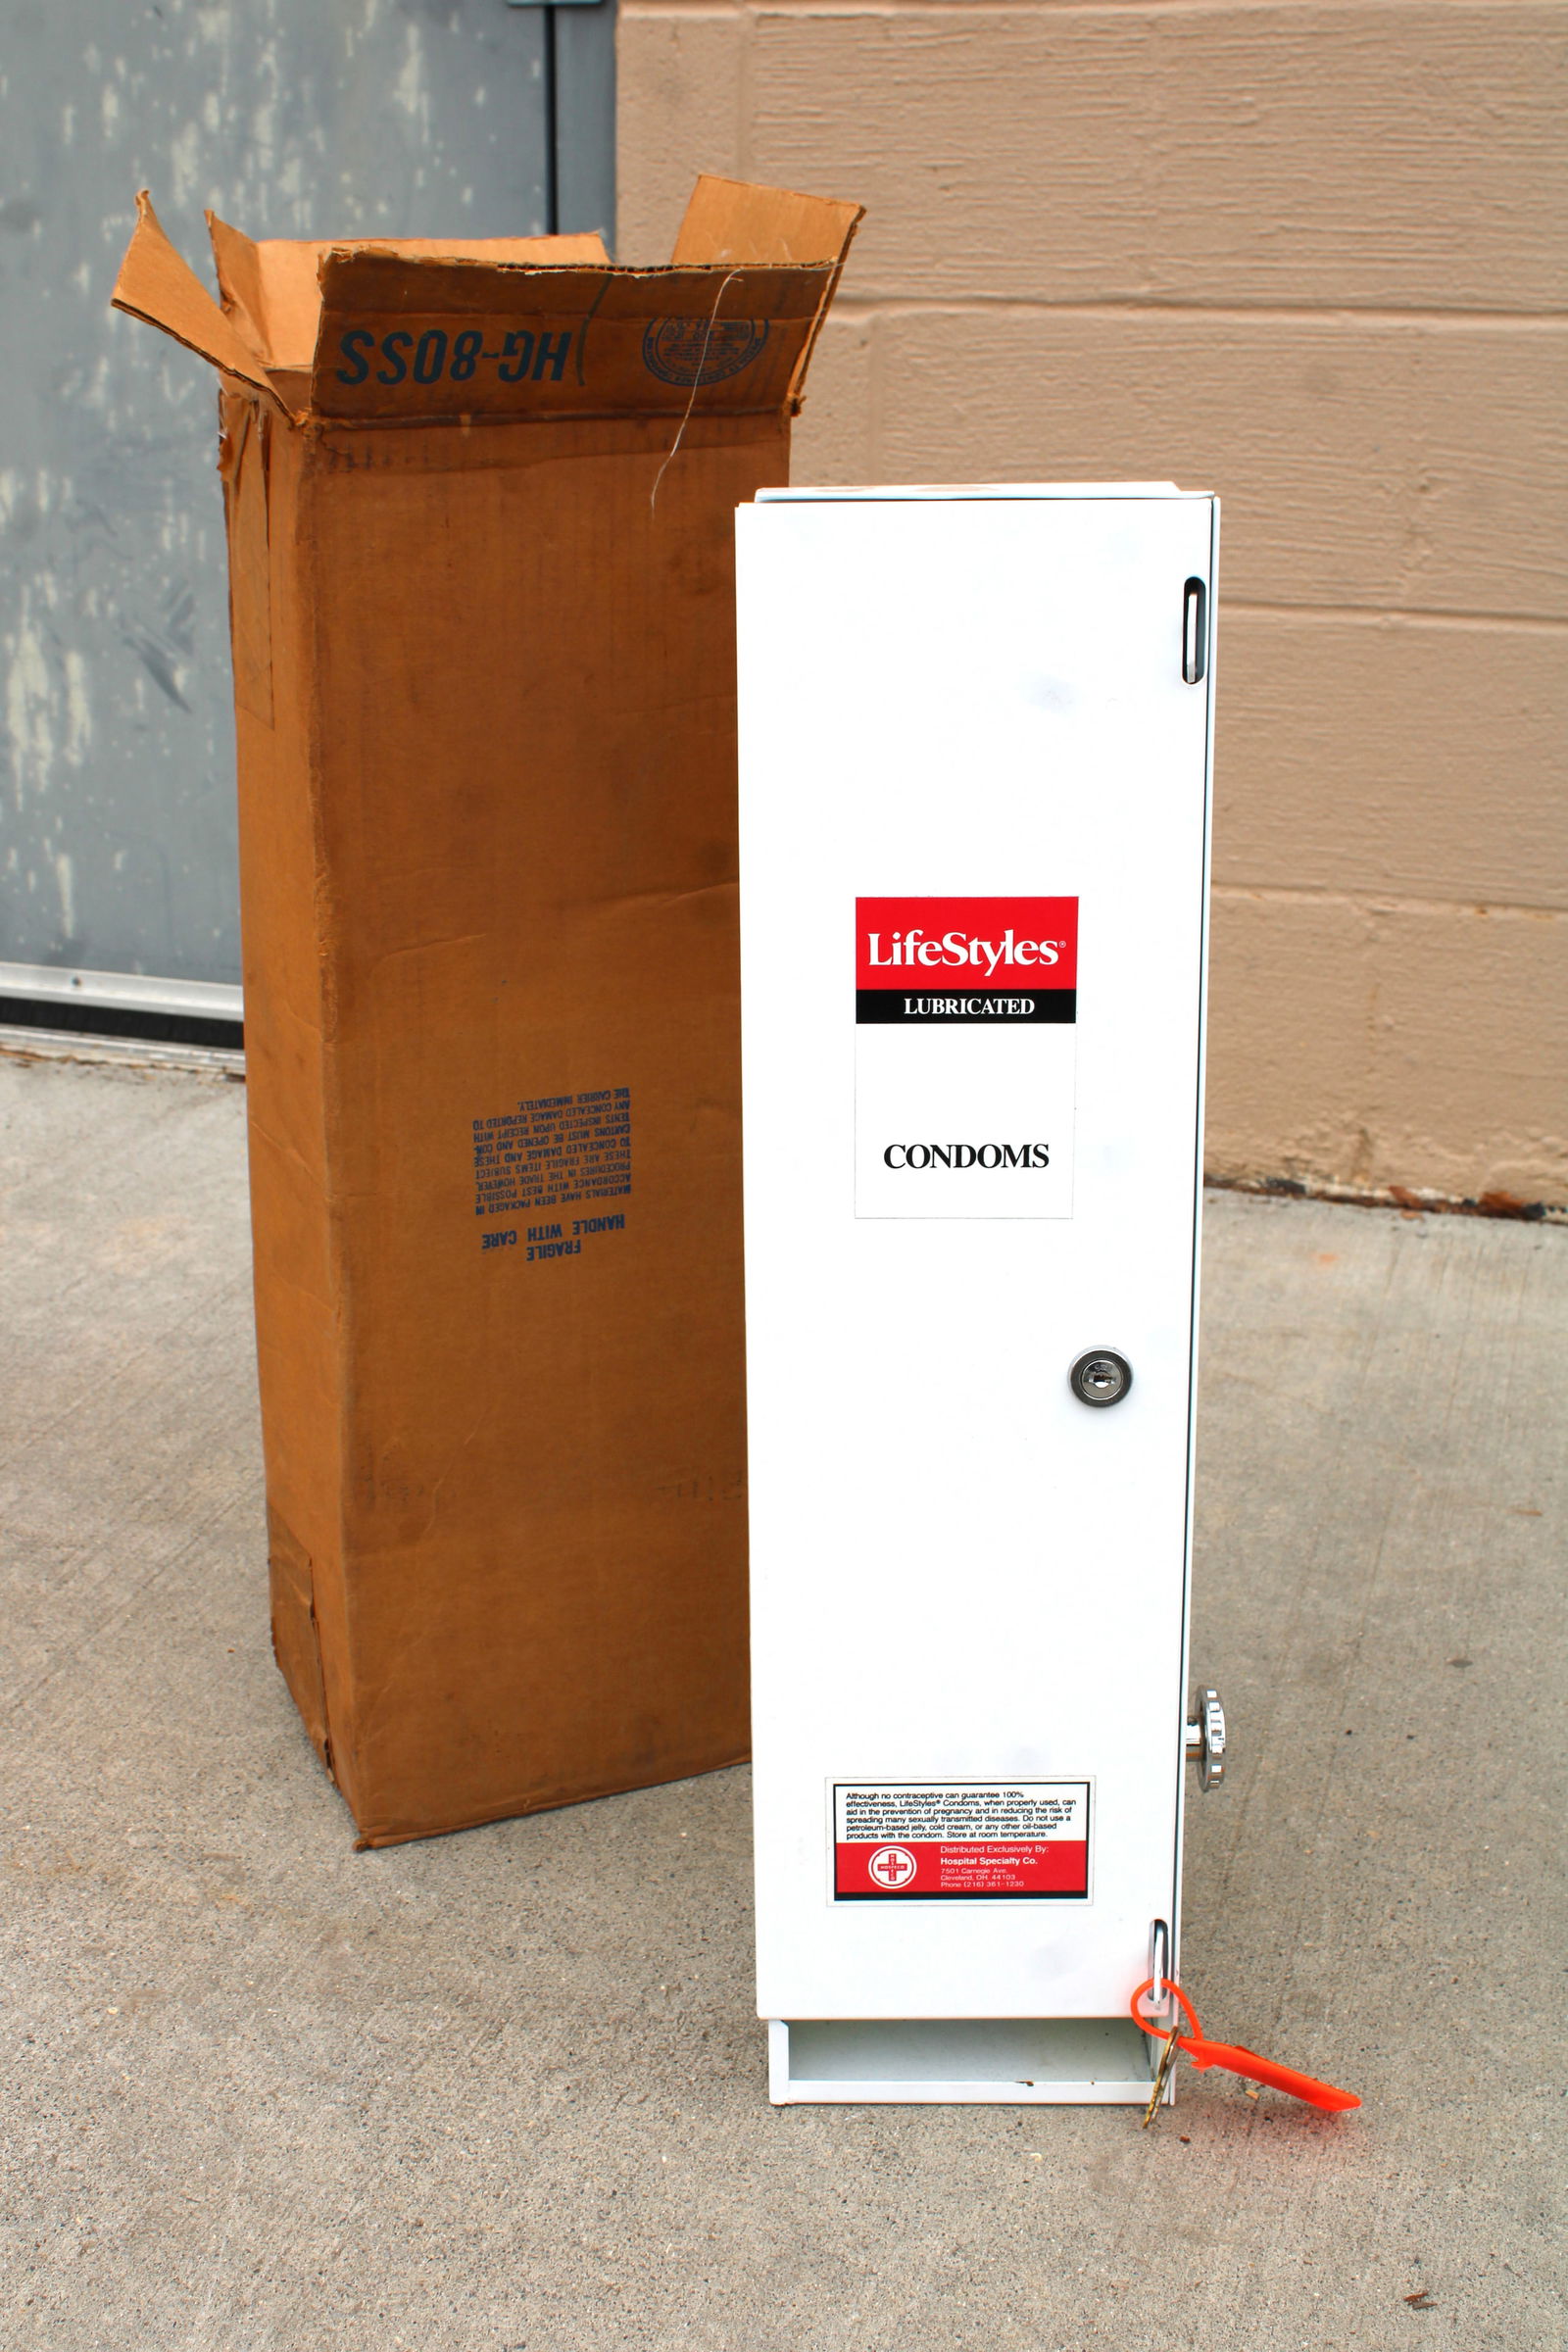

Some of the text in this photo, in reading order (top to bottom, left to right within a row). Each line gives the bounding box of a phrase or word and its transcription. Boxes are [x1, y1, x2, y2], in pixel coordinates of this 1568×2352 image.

[904, 998, 1035, 1015] LUBRICATED
[576, 1090, 611, 1103] CARRIER
[613, 1087, 630, 1099] THE
[472, 1101, 630, 1131] ANY CONCEALED DAMAGE REPORTED TO
[533, 1123, 556, 1134] UPON
[560, 1116, 601, 1132] INSPECTED
[473, 1132, 494, 1143] WITH
[498, 1126, 529, 1139] RECEIPT
[568, 1130, 589, 1142] MUST
[595, 1123, 630, 1139] CARTONS
[517, 1135, 549, 1149] OPENED
[553, 1134, 564, 1144] BE
[474, 1137, 630, 1167] TO CONCEALED DAMAGE AND THESE
[497, 1141, 514, 1152] AND
[884, 1144, 1050, 1168] CONDOMS
[475, 1149, 631, 1179] THESE ARE FRAGILE ITEMS SUBJECT
[580, 1161, 631, 1176] PROCEDURES
[549, 1171, 563, 1181] THE
[568, 1169, 576, 1178] IN
[475, 1172, 631, 1203] ACCORDANCE WITH BEST POSSIBLE
[586, 1184, 631, 1199] MATERIALS
[535, 1195, 556, 1206] BEEN
[561, 1189, 581, 1202] HAVE
[489, 1199, 530, 1212] PACKAGED
[482, 1213, 625, 1249] HANDLE WITH CARE
[526, 1240, 581, 1261] FRAGILE
[941, 1844, 1049, 1854] Distributed Exclusively By:
[941, 1856, 1038, 1866] Hospital Specialty Co.
